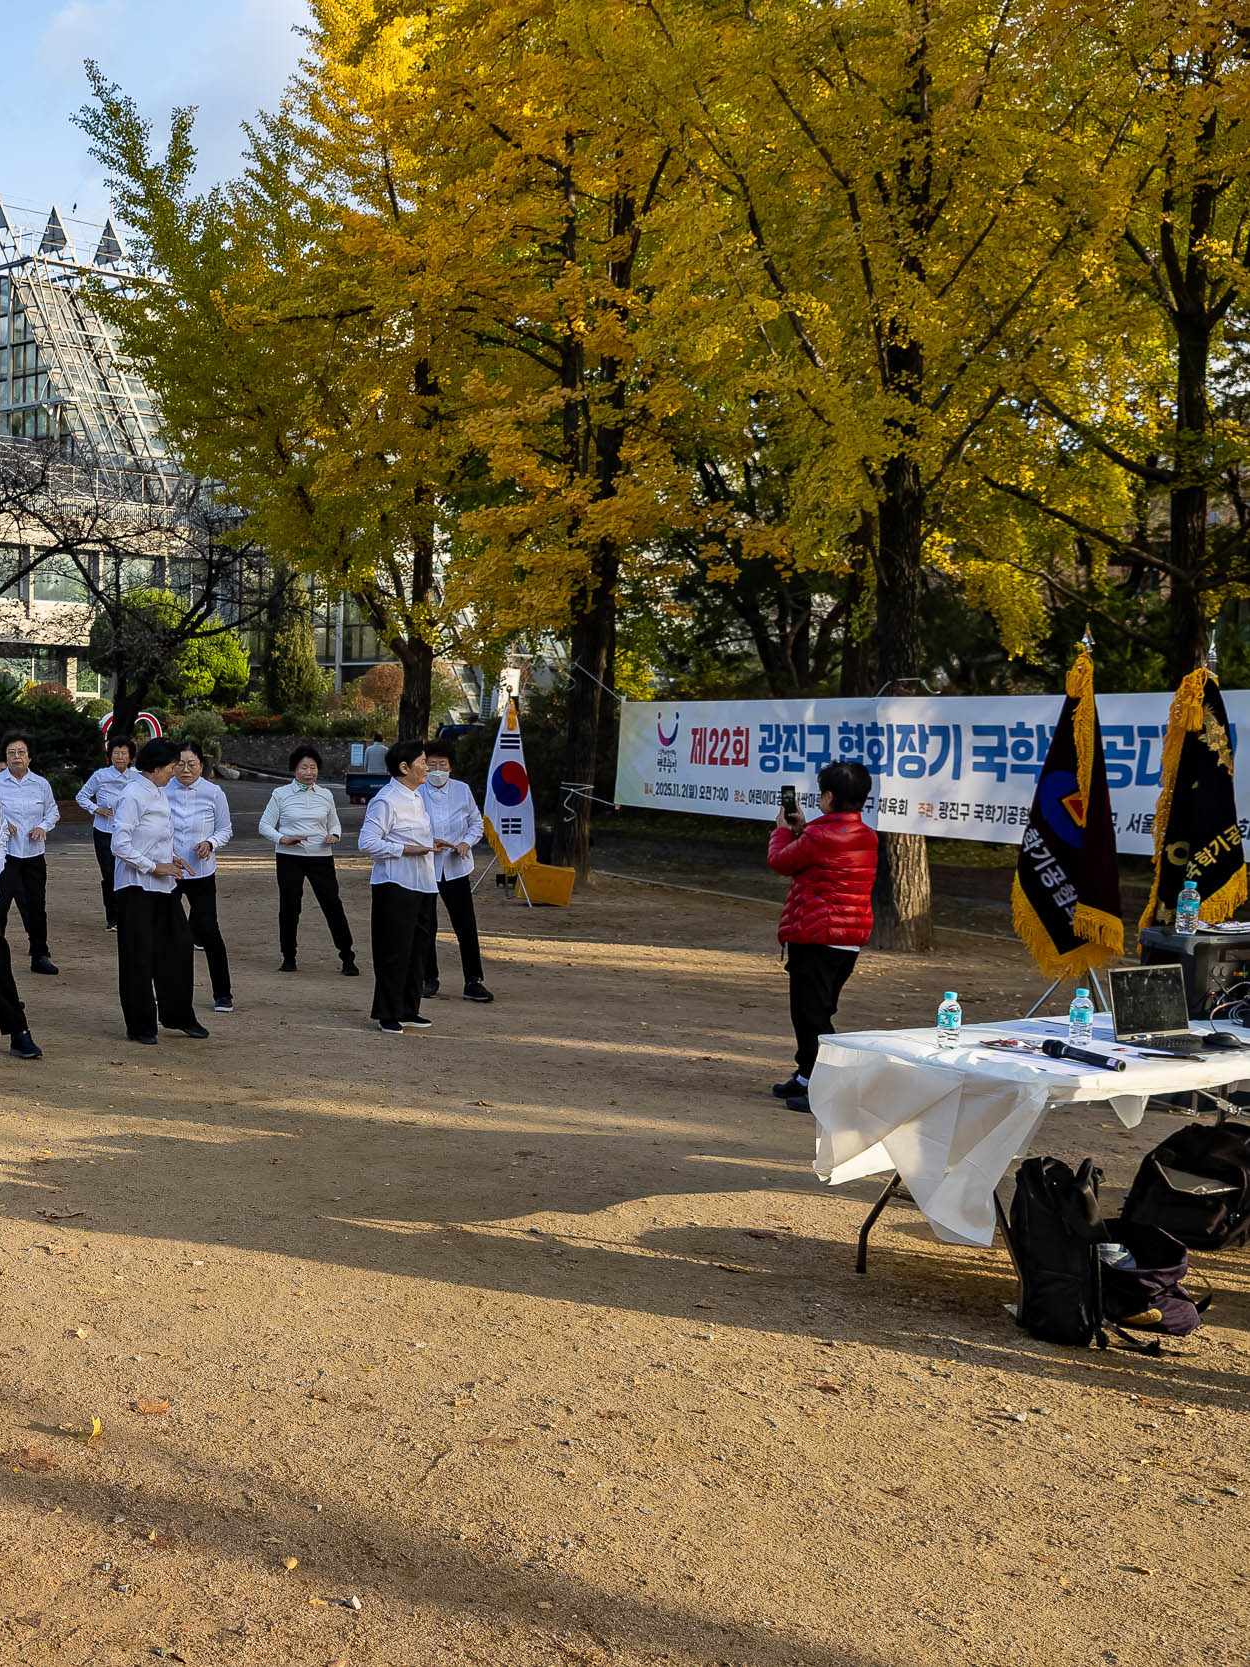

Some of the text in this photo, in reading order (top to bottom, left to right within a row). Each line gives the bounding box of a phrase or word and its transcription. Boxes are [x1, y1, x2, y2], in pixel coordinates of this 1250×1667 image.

[690, 721, 1238, 789] 제22회 광진구 협회장기 국학공
[938, 801, 970, 821] 광진구
